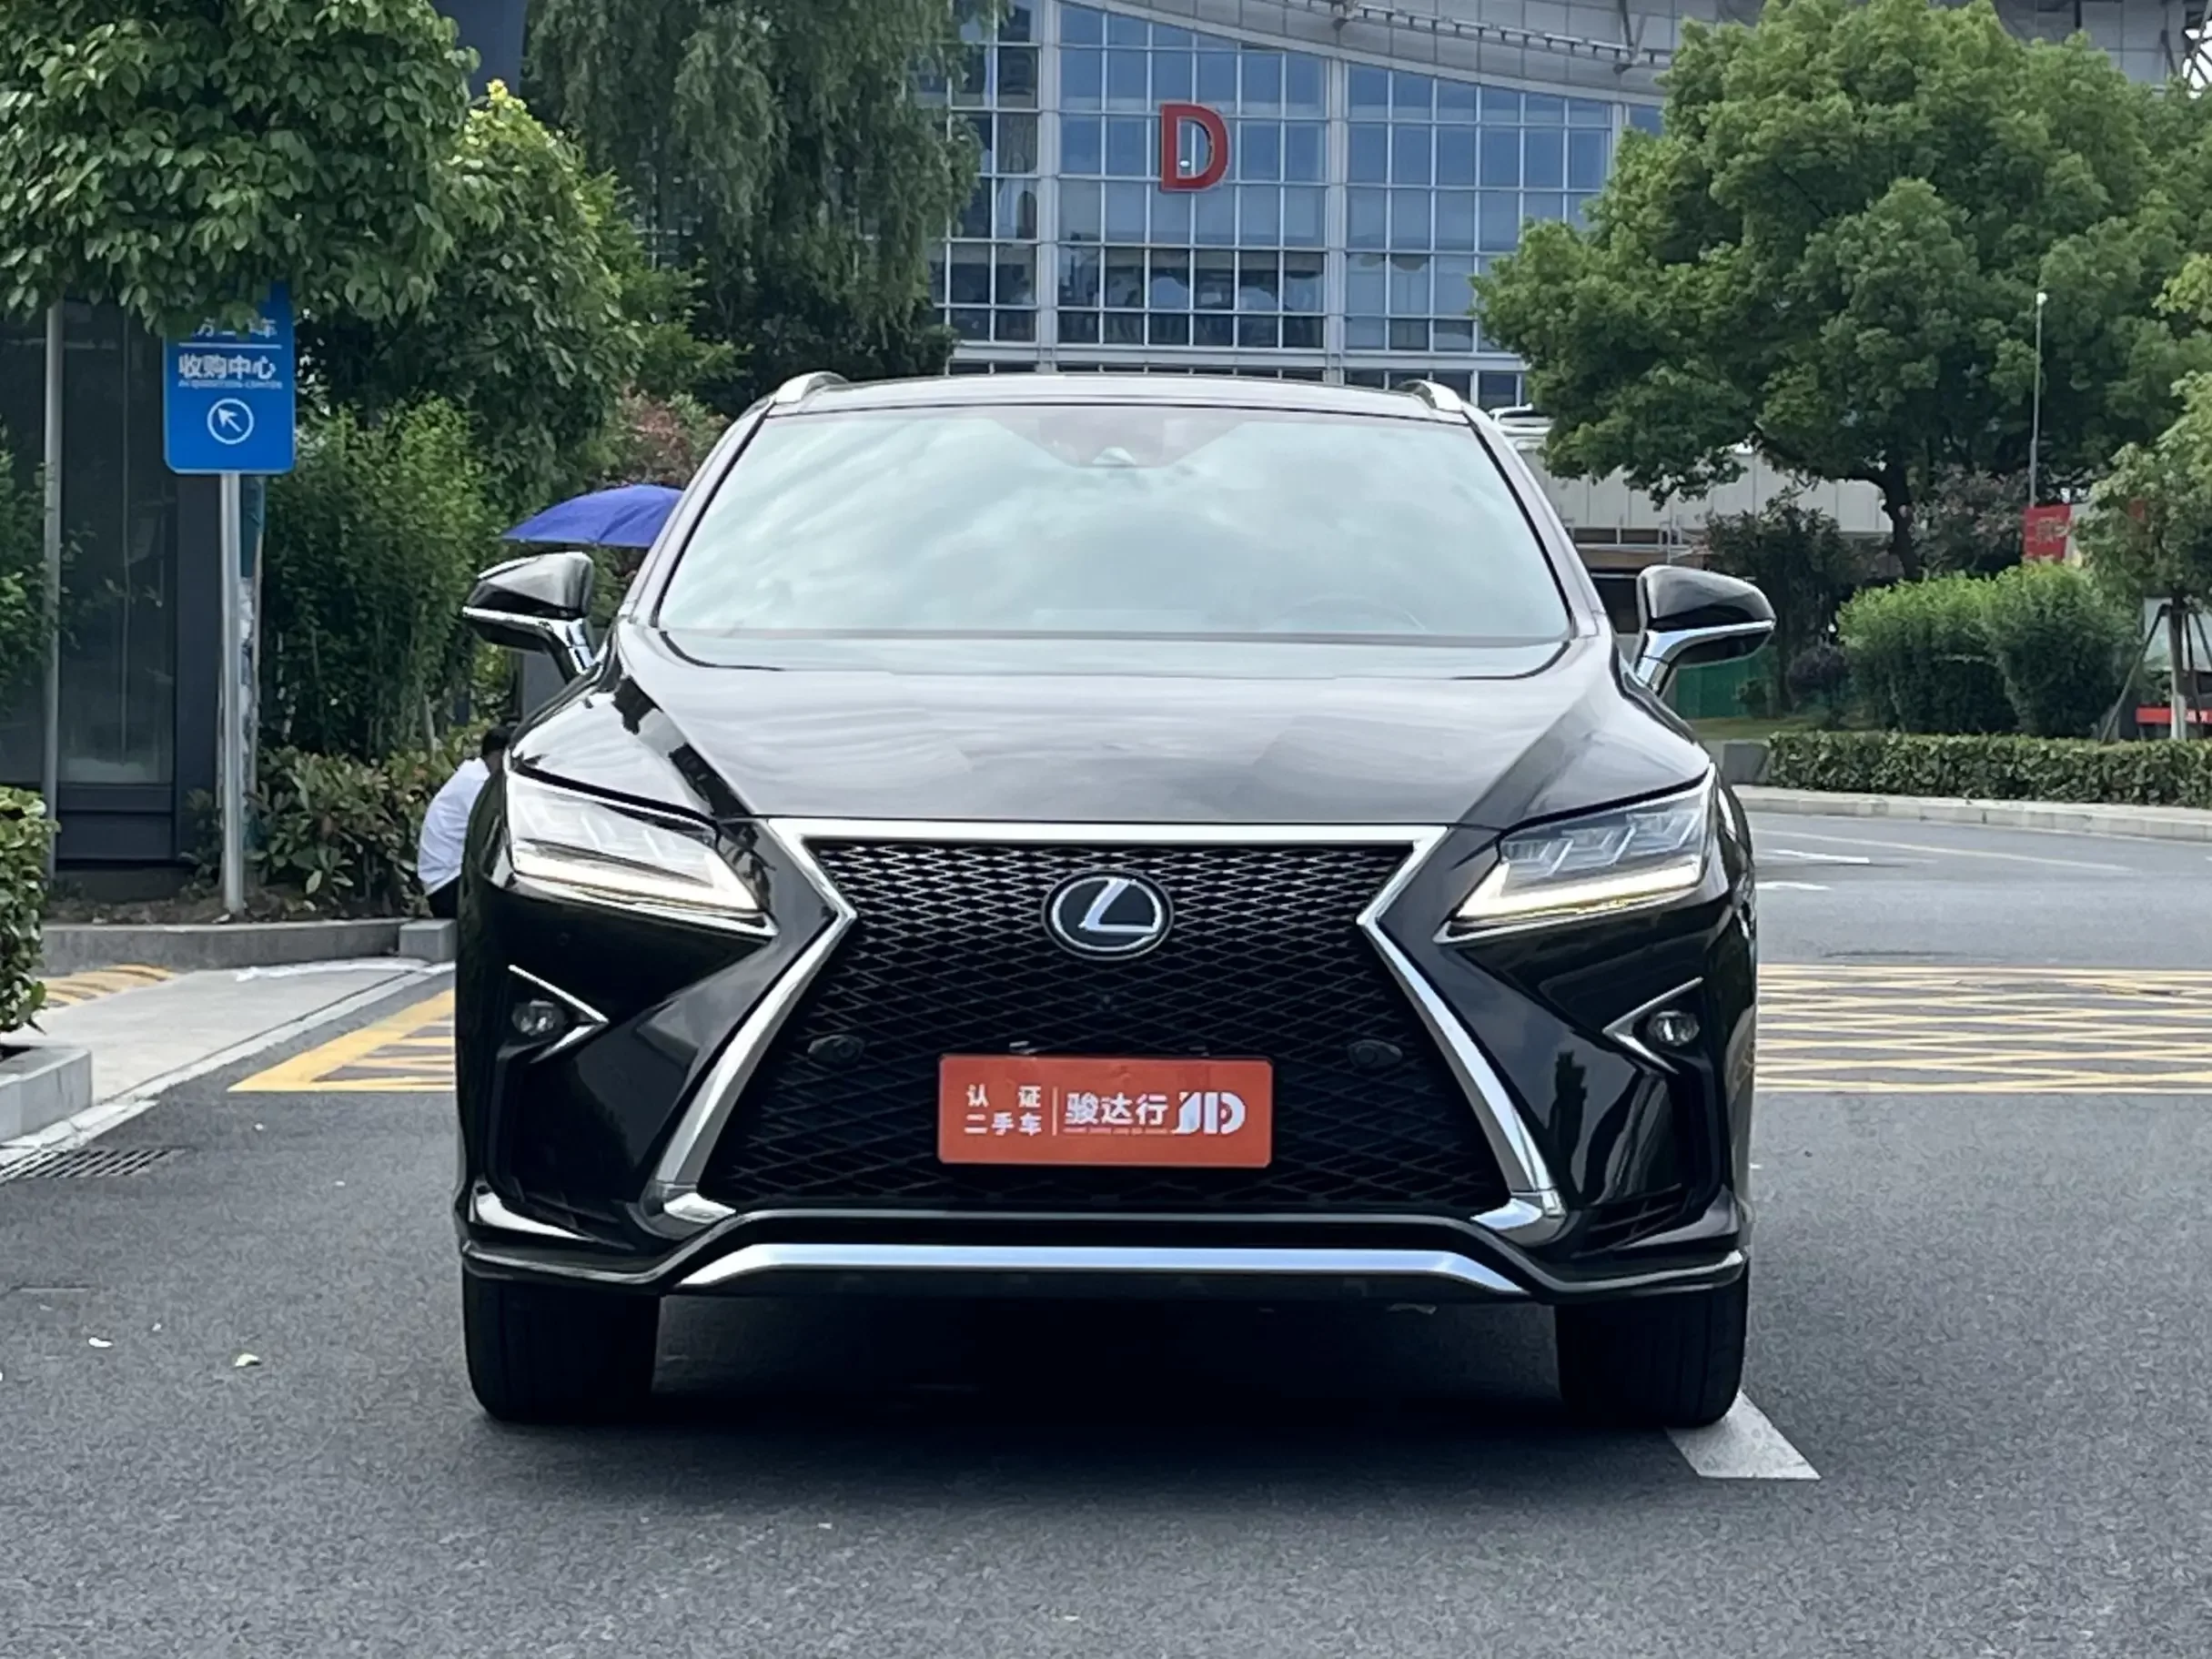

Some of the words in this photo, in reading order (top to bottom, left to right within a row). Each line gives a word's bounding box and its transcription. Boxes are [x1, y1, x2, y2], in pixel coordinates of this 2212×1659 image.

[1160, 101, 1231, 193] D
[178, 354, 277, 379] 收购中心
[965, 1083, 1042, 1108] 认证
[1064, 1092, 1169, 1125] 骏达行
[964, 1112, 1042, 1137] 二手车
